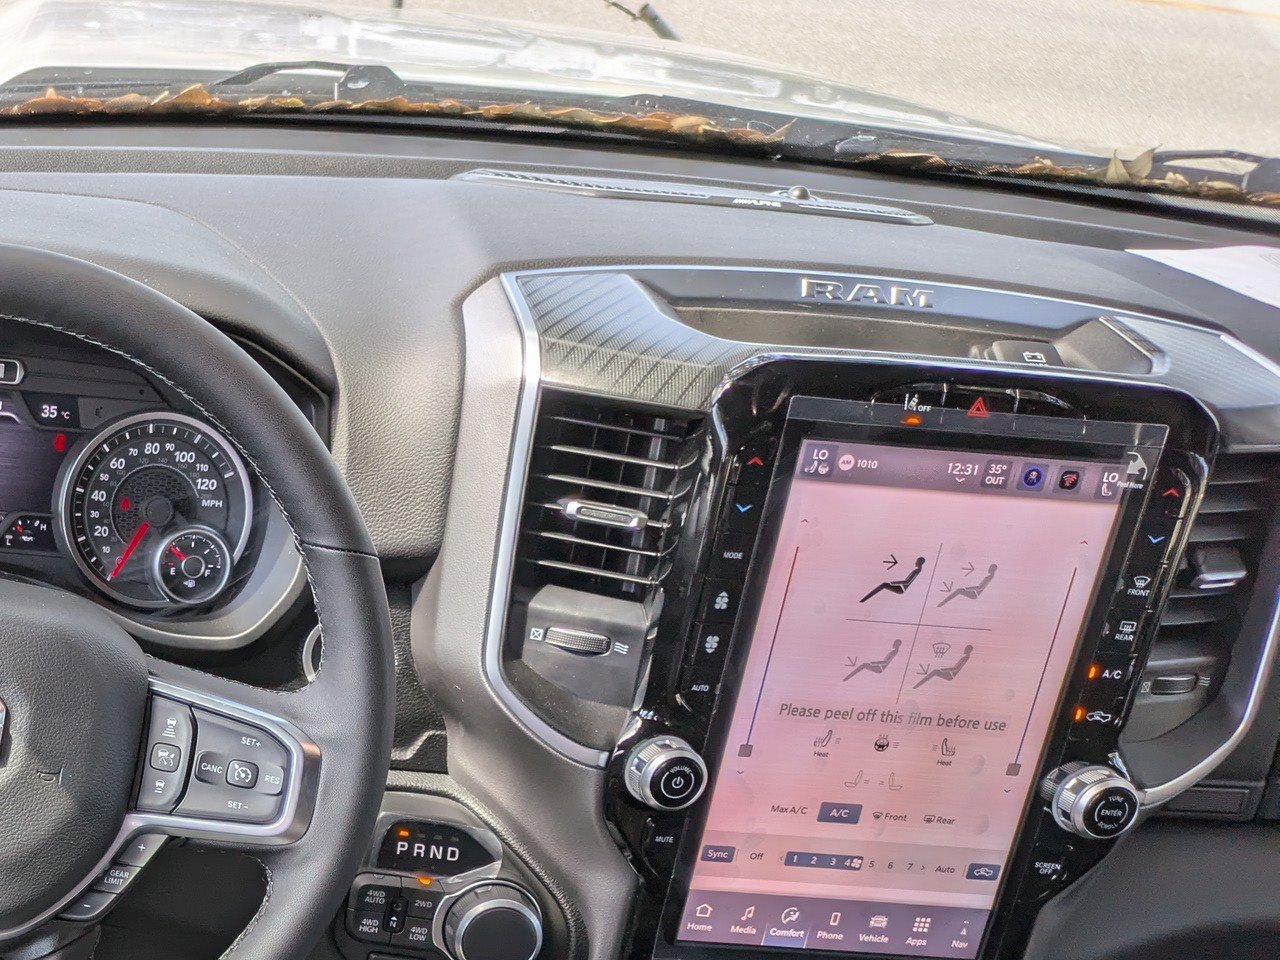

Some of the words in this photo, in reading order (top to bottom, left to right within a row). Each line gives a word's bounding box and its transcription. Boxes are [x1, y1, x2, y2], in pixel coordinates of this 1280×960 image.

[801, 277, 934, 308] RAM
[41, 404, 58, 418] 35
[128, 448, 138, 456] 70
[144, 442, 160, 454] 80
[165, 443, 175, 451] 90
[174, 452, 196, 463] 100
[813, 449, 829, 460] LO
[110, 458, 125, 469] 60
[195, 463, 209, 472] 110
[857, 459, 878, 469] 1010
[947, 462, 979, 476] 12:31
[100, 473, 109, 481] 50
[985, 475, 1005, 486] OUT
[1103, 472, 1118, 482] LO
[196, 478, 217, 490] 120
[91, 490, 107, 502] 40
[201, 499, 223, 507] MPH
[90, 510, 100, 518] 30
[40, 523, 47, 531] H
[94, 525, 109, 537] 20
[102, 546, 111, 554] 10
[723, 552, 743, 560] MODE
[170, 567, 176, 576] E
[204, 569, 211, 577] F
[1127, 589, 1150, 597] FRONT
[1115, 633, 1134, 642] REAR
[1102, 669, 1122, 680] A/C
[691, 684, 709, 692] AUTO
[778, 702, 821, 719] Please
[824, 706, 854, 722] peel
[857, 708, 877, 722] off
[880, 709, 903, 724] this
[908, 711, 932, 726] film
[936, 714, 979, 730] before
[983, 719, 1007, 732] use
[936, 758, 952, 767] Heat
[201, 762, 223, 774] CANC
[669, 765, 693, 775] VOLUME
[264, 774, 280, 785] RES
[770, 804, 789, 815] Max
[789, 804, 808, 816] A/C
[829, 807, 850, 818] A/C
[1101, 809, 1123, 817] ENTER
[884, 811, 907, 822] Front
[936, 815, 956, 826] Rear
[655, 835, 673, 843] MUTE
[707, 849, 729, 860] Sync
[750, 851, 763, 861] Off
[792, 854, 798, 863] 1
[811, 856, 817, 865] 2
[830, 857, 836, 866] 3
[844, 858, 850, 867] 4
[869, 860, 874, 869] 5
[887, 861, 893, 870] 6
[907, 862, 913, 872] 7
[1035, 861, 1061, 871] SCREEN
[109, 869, 130, 879] GEAR
[935, 865, 956, 874] Auto
[104, 876, 124, 886] LIMIT
[367, 890, 386, 898] 4WD
[364, 896, 385, 904] AUTO
[414, 899, 433, 908] 2WD
[361, 918, 379, 926] 4WD
[359, 925, 378, 933] HIGH
[410, 926, 428, 934] 4WD
[409, 933, 427, 941] LOW
[687, 922, 712, 932] Home
[730, 924, 756, 936] Media
[769, 927, 804, 939] Comfort
[817, 930, 843, 941] Phone
[859, 932, 889, 944] Vehicle
[905, 936, 927, 948] Apps
[951, 939, 968, 949] Nav
